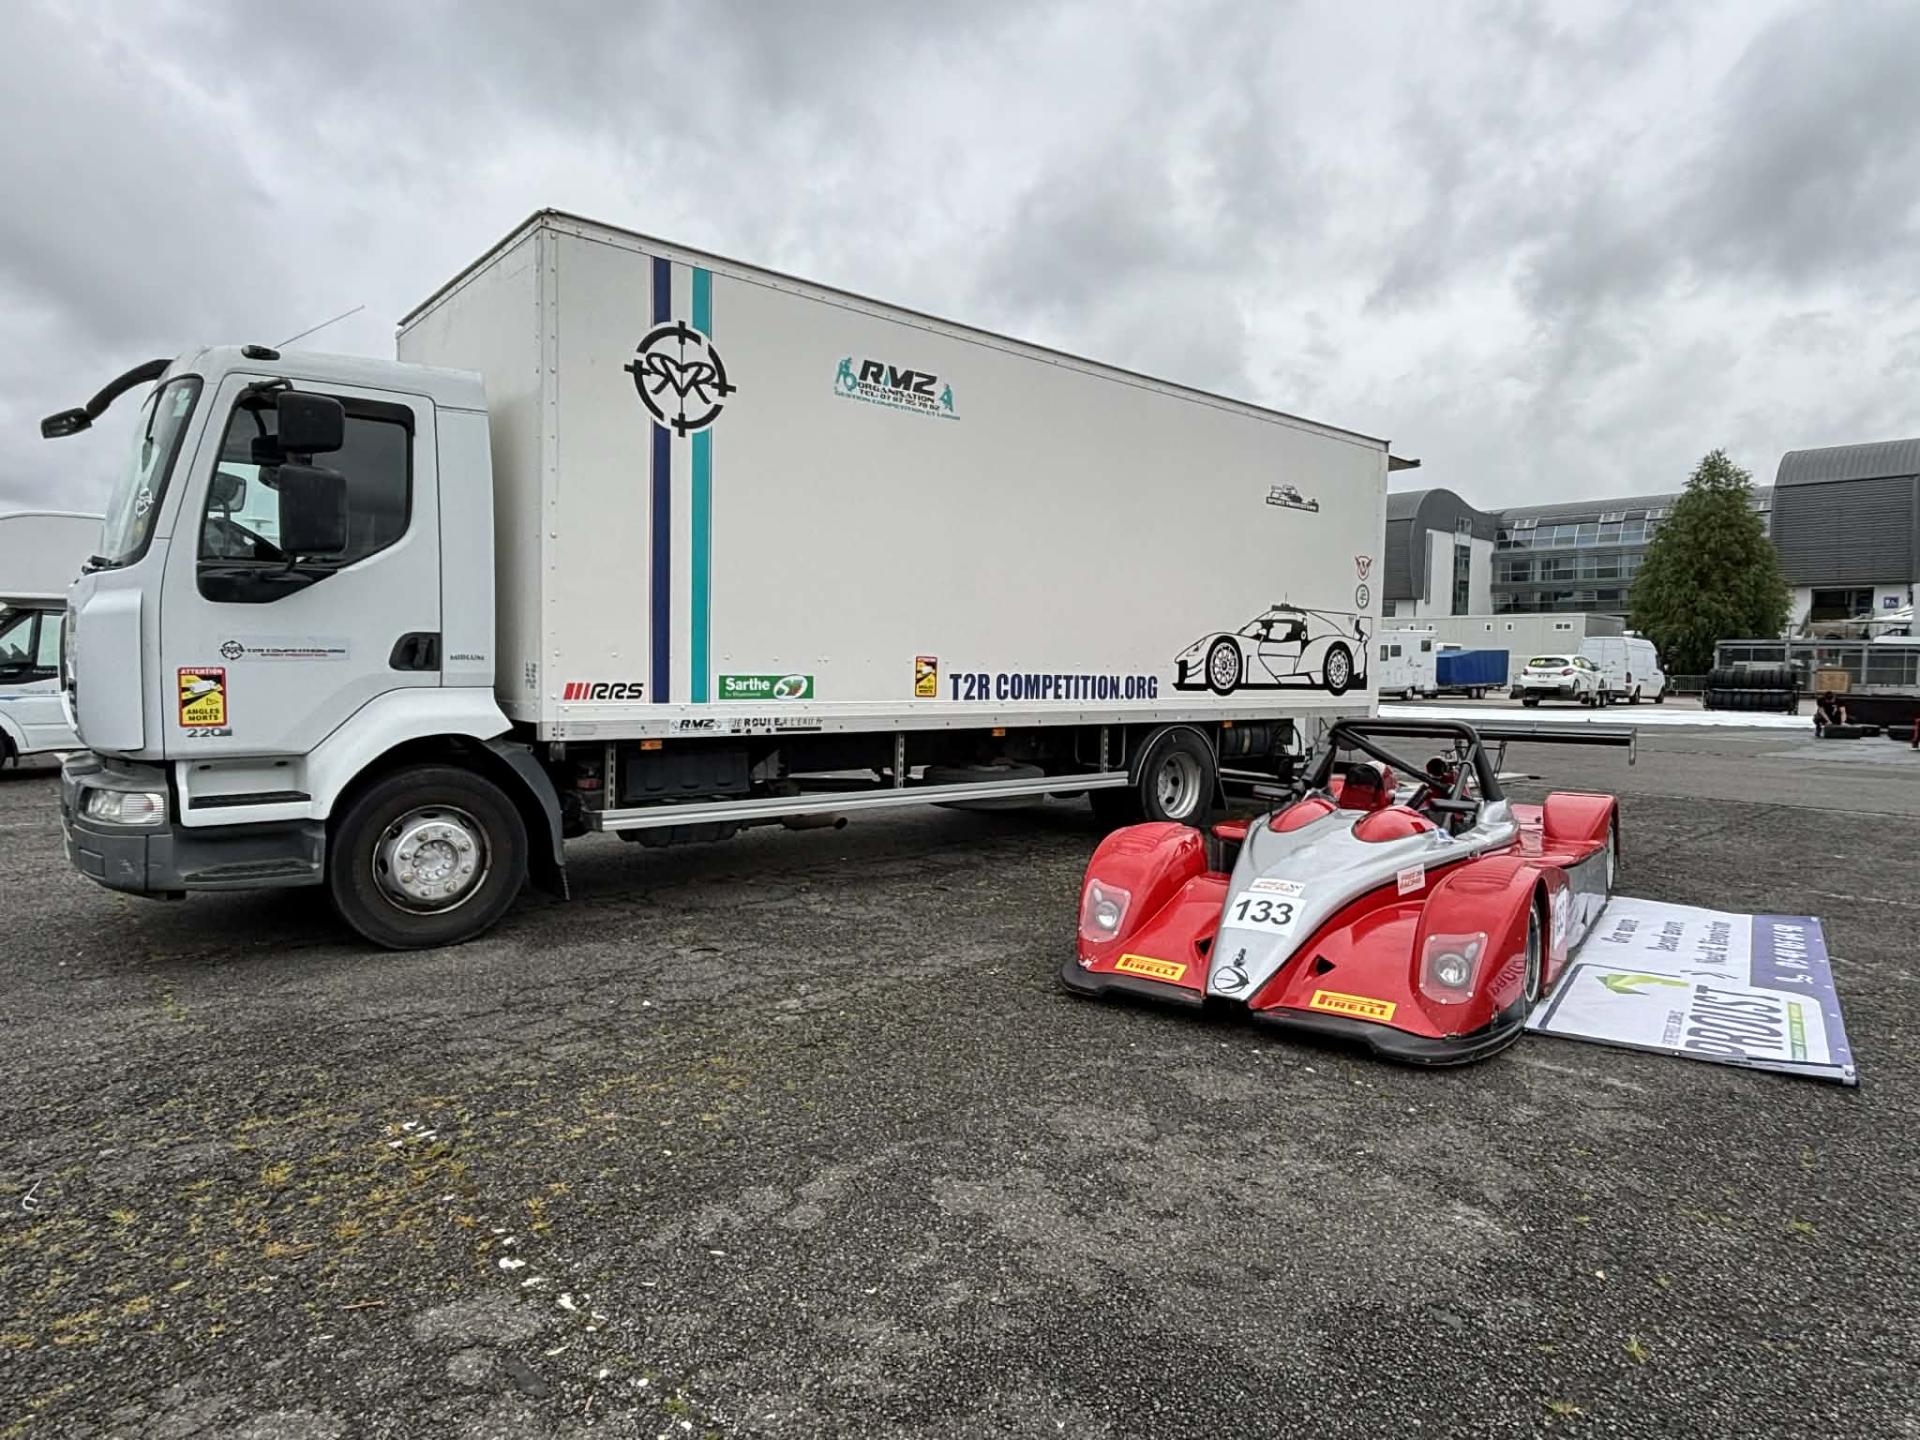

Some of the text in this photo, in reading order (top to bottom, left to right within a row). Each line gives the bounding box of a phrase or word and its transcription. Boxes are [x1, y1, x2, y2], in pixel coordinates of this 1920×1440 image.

[858, 359, 938, 396] RMZ
[857, 381, 936, 403] ORGANISATION
[589, 683, 645, 700] RRS
[725, 677, 770, 691] Sarthe
[949, 673, 1158, 701] T2R COMPETITION.ORG
[679, 719, 715, 728] RMZ
[1235, 899, 1294, 926] 133
[1122, 957, 1180, 977] PIRELLI
[1317, 994, 1389, 1016] PIRELLI
[1685, 984, 1784, 1057] PROUST
